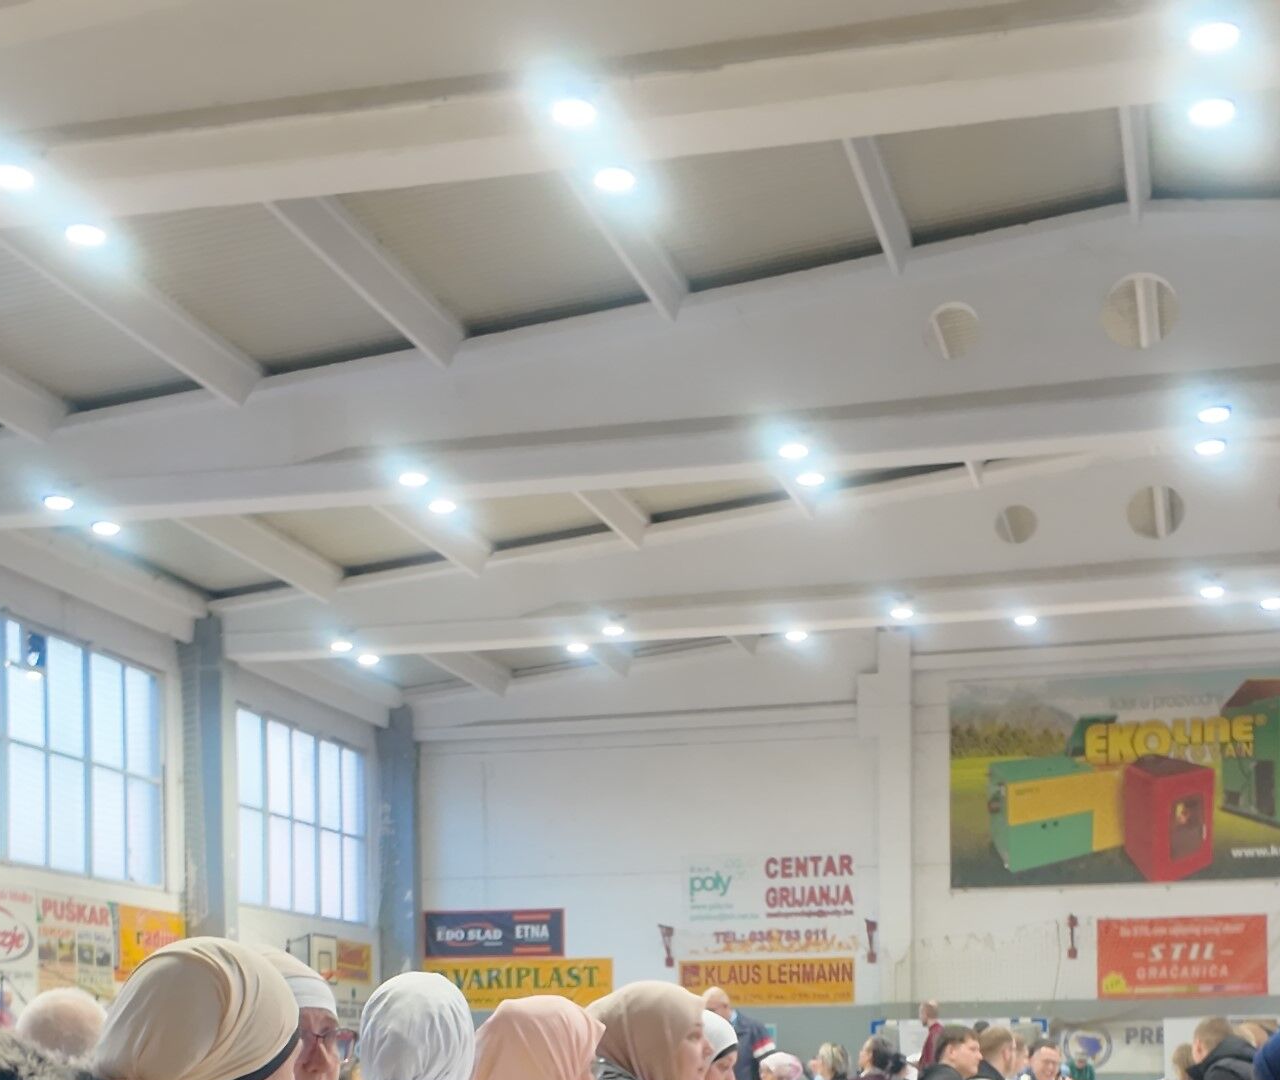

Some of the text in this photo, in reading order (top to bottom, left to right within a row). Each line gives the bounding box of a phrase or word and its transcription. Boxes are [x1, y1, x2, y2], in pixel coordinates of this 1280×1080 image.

[765, 855, 854, 879] CENTAR
[689, 870, 732, 897] poly
[765, 885, 854, 910] GRIJANJA
[514, 924, 551, 940] ETNA
[1149, 942, 1215, 962] STIL
[453, 965, 600, 991] VARIPLAST
[705, 962, 853, 986] KLAUS LEHMANN
